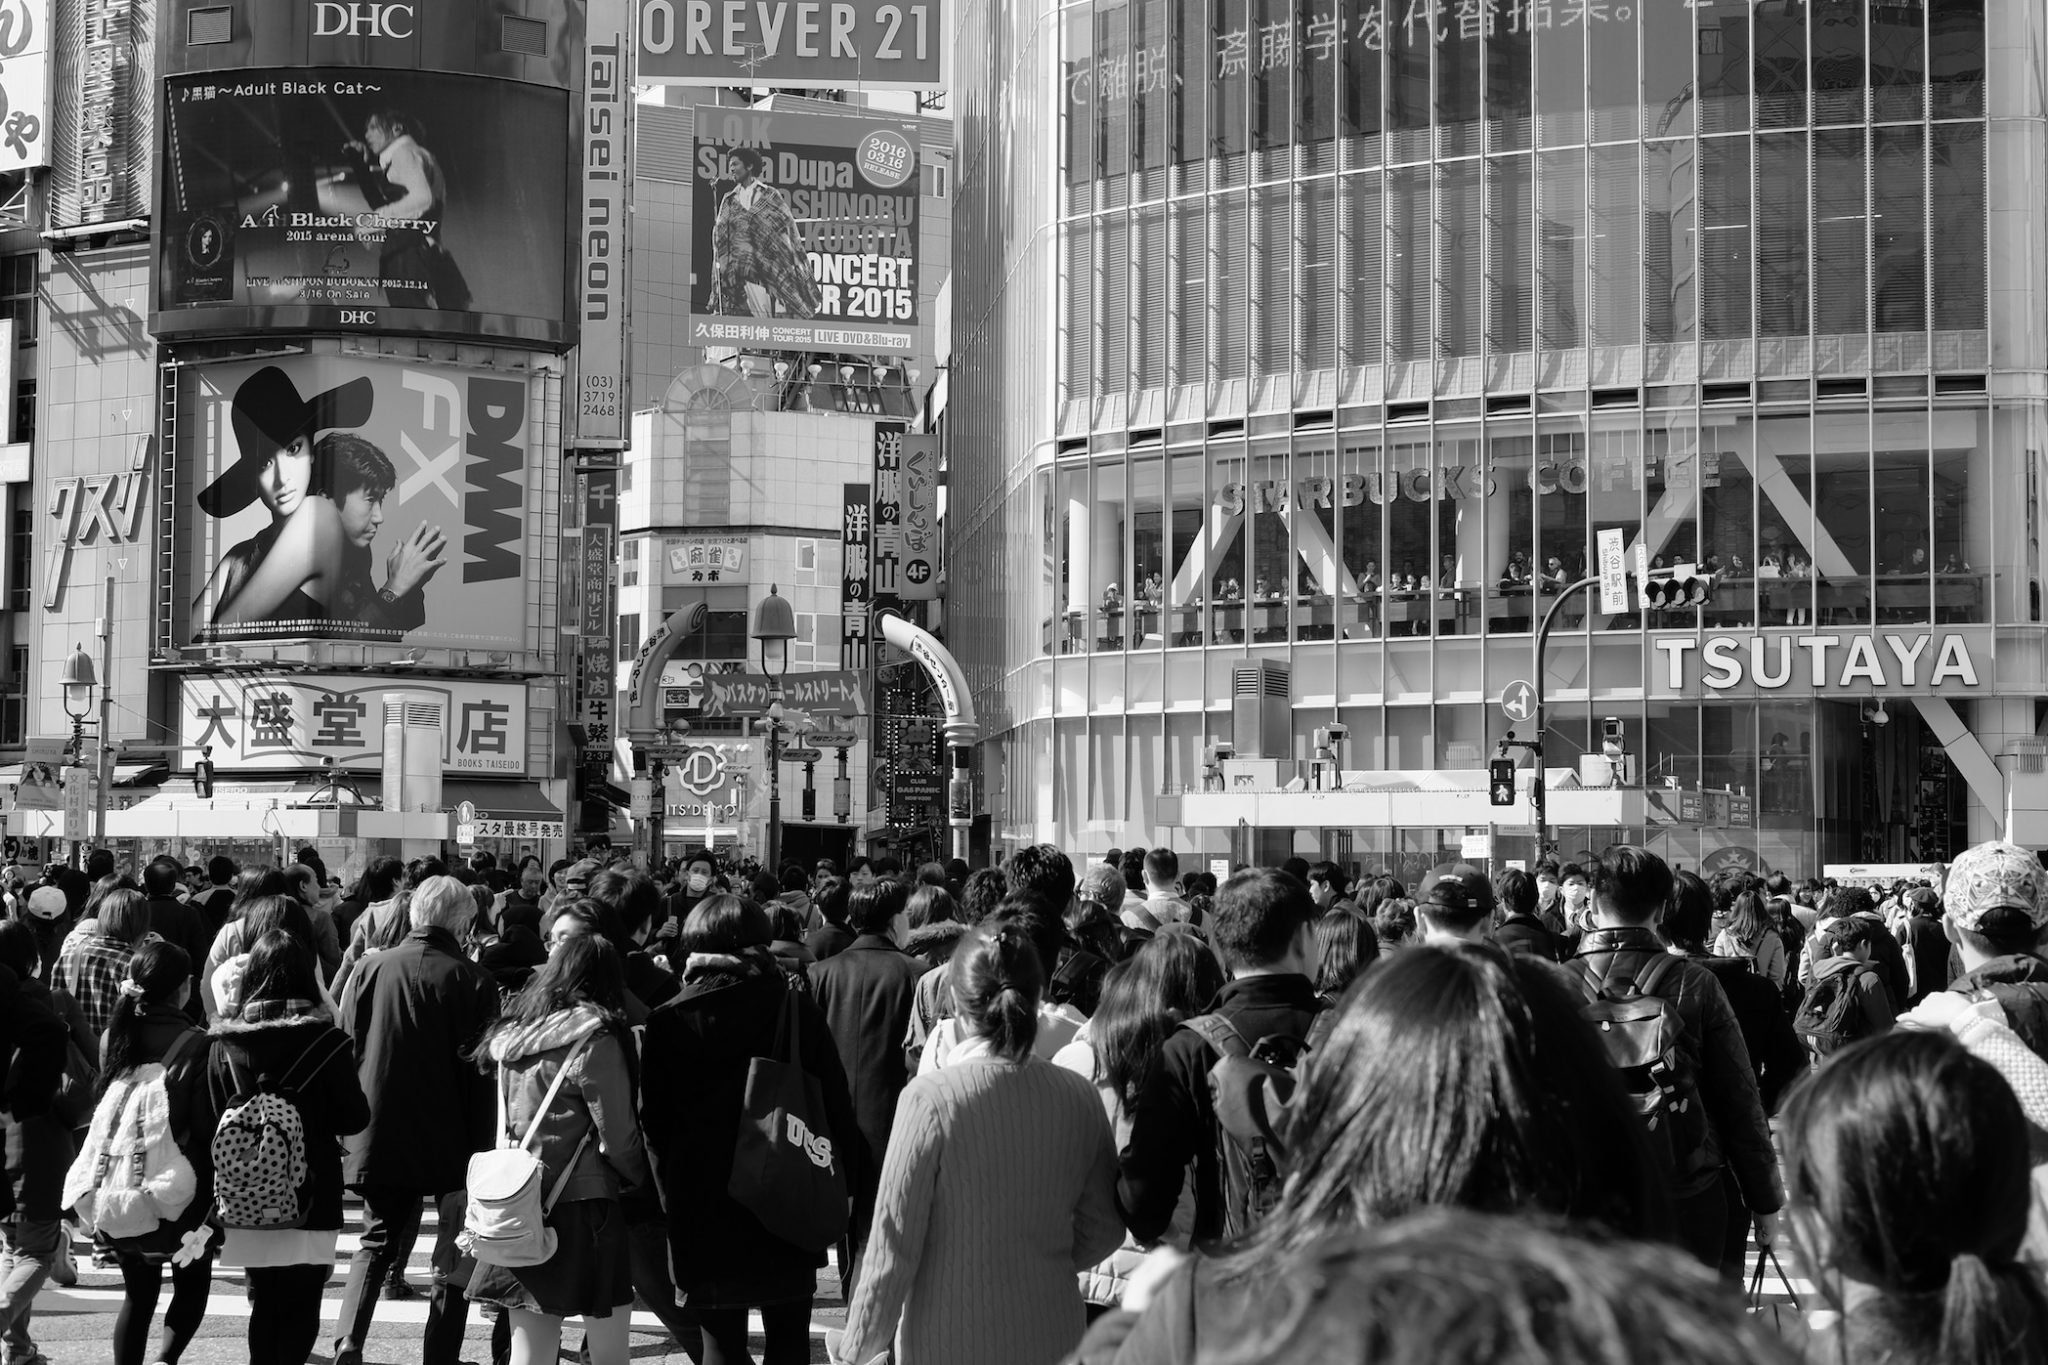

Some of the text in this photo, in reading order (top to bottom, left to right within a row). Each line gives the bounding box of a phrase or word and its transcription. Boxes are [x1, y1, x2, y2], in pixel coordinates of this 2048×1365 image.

[313, 2, 414, 39] DHC
[641, 0, 928, 60] OREVER 21
[282, 82, 327, 95] Black
[699, 112, 773, 149] L.O.K
[869, 137, 907, 159] 2016
[697, 146, 854, 190] Sua Dupa
[867, 149, 904, 170] 03.16
[587, 33, 619, 321] Taisei neon
[863, 162, 901, 180] RELEASE
[780, 188, 914, 227] OSHINOBU
[290, 212, 353, 228] Black
[356, 212, 438, 234] Cherry
[286, 231, 387, 243] 2015 arena tour
[804, 222, 913, 258] KUBOTA
[806, 252, 913, 288] ONCERT
[246, 278, 270, 288] LIVE
[283, 277, 323, 288] NIPPON
[326, 277, 379, 288] BUDOKAN
[327, 290, 342, 299] On
[346, 290, 370, 299] Sale
[847, 286, 913, 320] 2015
[340, 310, 375, 325] DHC
[695, 322, 770, 341] 久保田利伸
[772, 326, 812, 336] CONCERT
[772, 334, 812, 343] TOUR 2015
[818, 330, 909, 348] LIVE DVD&Blu-ray
[586, 375, 613, 389] (03)
[583, 391, 615, 403] 3719
[583, 404, 615, 417] 2468
[399, 369, 461, 509] FX
[463, 376, 526, 585] DMM
[1221, 452, 1721, 517] STARBUCKS COFFEE
[874, 431, 900, 594] 洋服の青山
[690, 546, 722, 565] 麻雀
[907, 563, 929, 580] 4F
[1608, 536, 1624, 606] 渋谷駅前
[842, 504, 868, 670] 洋服の青山
[1655, 633, 1979, 689] TSUTAYA
[195, 691, 509, 754] 大盛堂店
[457, 759, 520, 769] BOOKS TAISEIDO
[474, 821, 563, 838] スタ最終号発売
